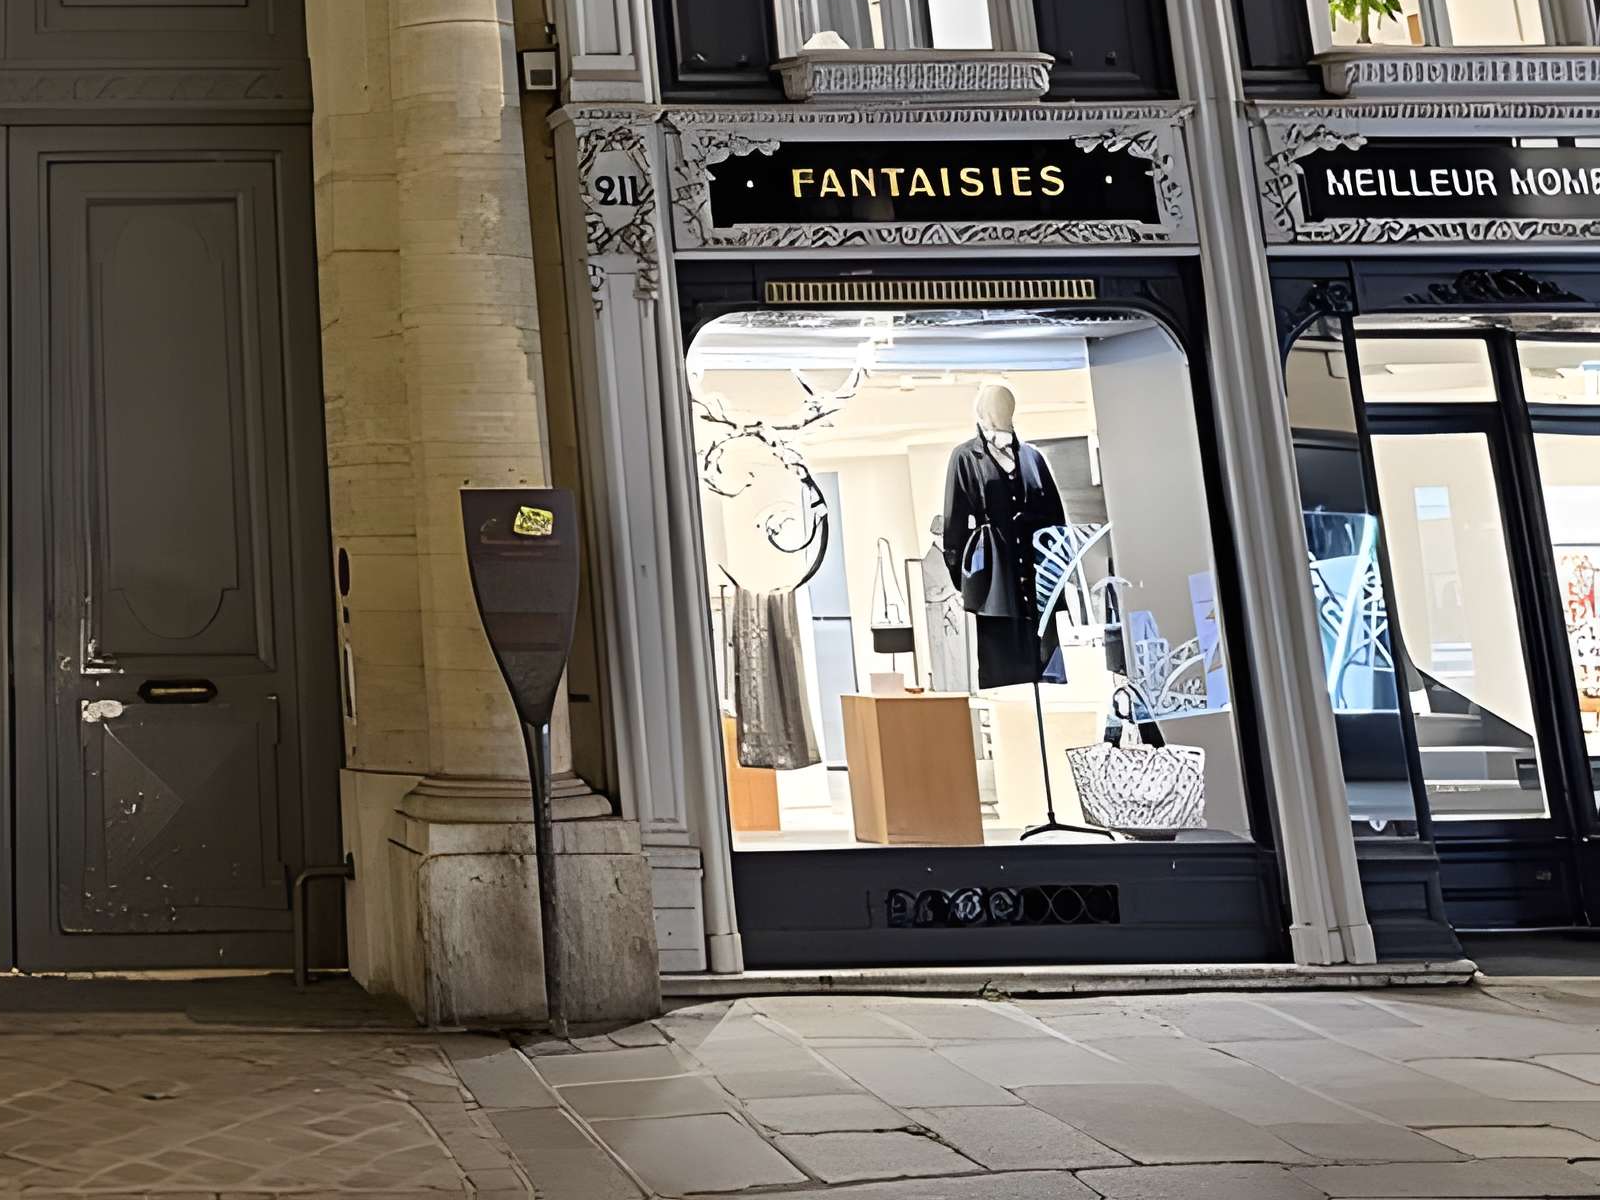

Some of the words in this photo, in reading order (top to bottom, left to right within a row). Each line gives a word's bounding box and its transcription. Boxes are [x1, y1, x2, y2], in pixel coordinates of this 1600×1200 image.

[595, 175, 641, 206] 211
[791, 165, 1065, 198] FANTAISIES
[1326, 168, 1498, 197] MEILLEUR
